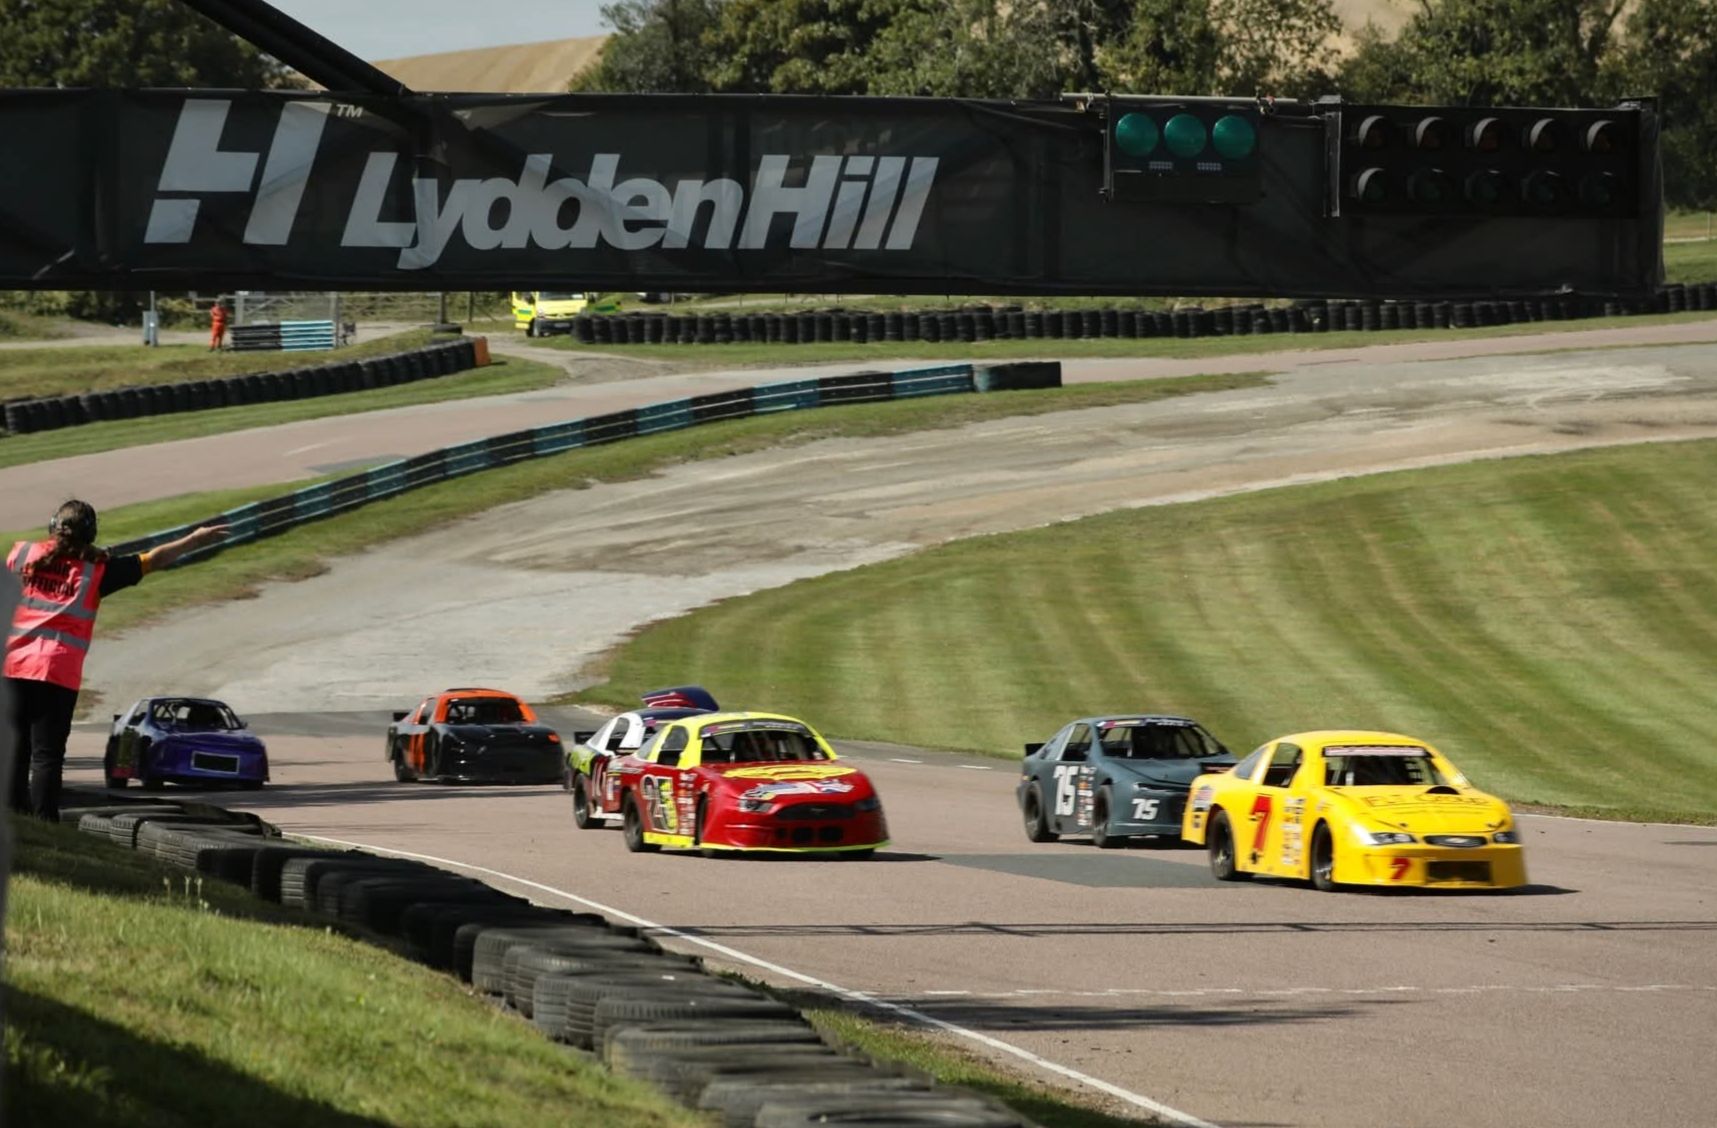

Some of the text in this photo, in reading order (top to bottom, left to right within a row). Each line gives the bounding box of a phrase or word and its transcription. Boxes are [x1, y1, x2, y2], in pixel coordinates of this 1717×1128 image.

[336, 103, 363, 118] TM
[1053, 765, 1080, 816] 75
[1131, 798, 1161, 820] 75
[1250, 794, 1273, 853] 7
[1391, 857, 1411, 881] 7
